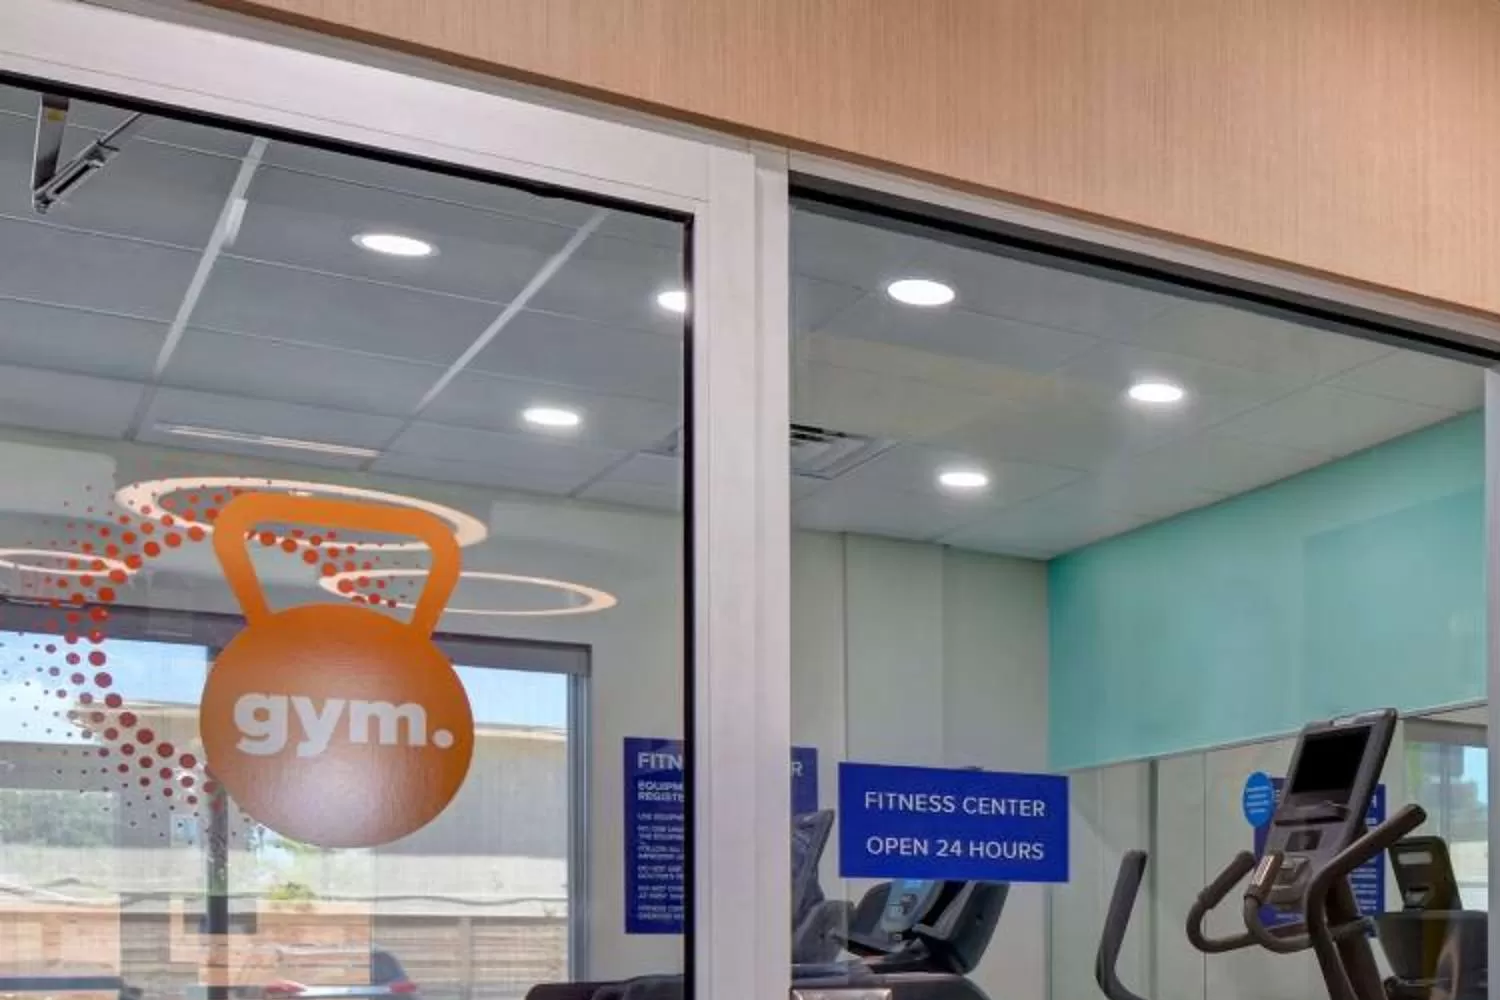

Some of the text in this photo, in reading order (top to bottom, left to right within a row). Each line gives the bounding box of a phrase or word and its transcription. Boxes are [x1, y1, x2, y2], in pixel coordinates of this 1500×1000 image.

[233, 692, 455, 757] gym.
[864, 791, 1046, 817] FITNESS CENTER
[866, 836, 1045, 861] OPEN 24 HOURS
